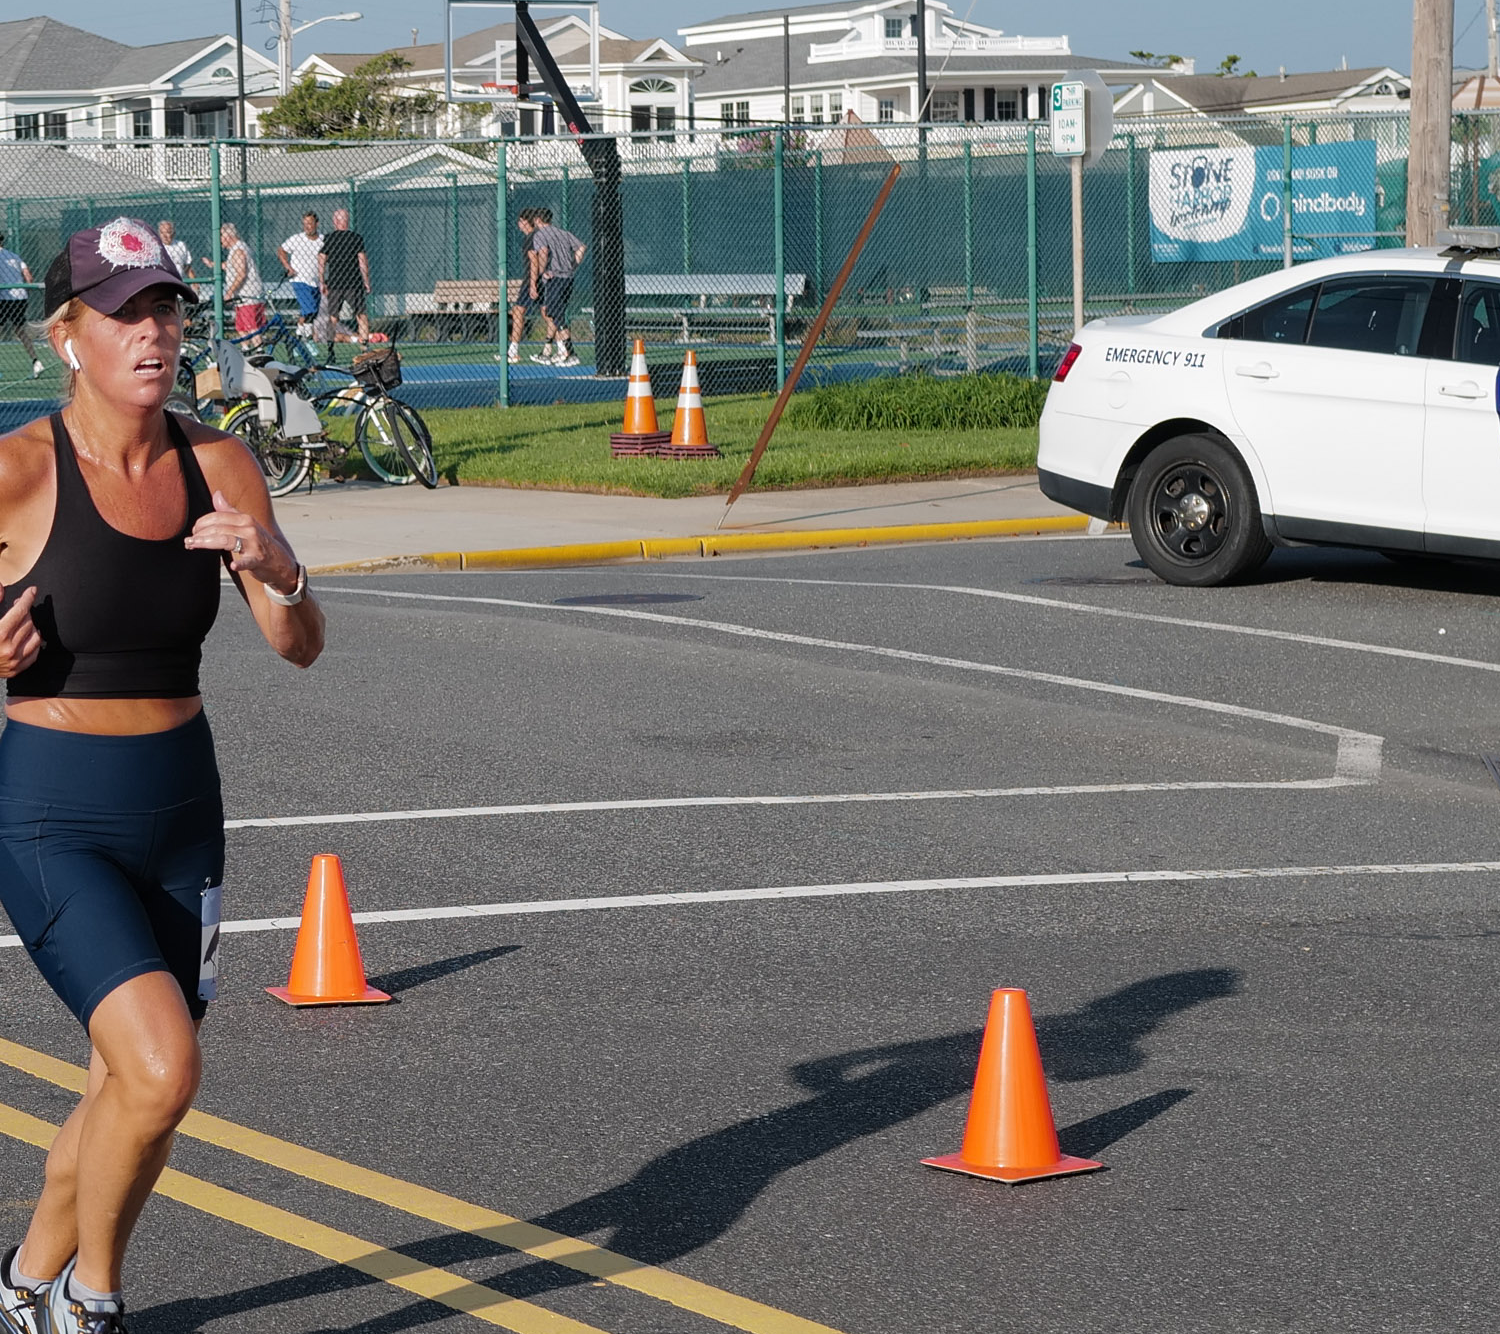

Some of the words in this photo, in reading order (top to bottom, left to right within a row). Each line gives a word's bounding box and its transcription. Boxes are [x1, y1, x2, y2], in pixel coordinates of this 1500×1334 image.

[1054, 88, 1062, 107] 3
[1062, 97, 1083, 107] PARKING
[1058, 118, 1078, 129] 10AM-
[1061, 134, 1076, 144] 9PM
[1169, 156, 1234, 190] STONE
[1105, 347, 1182, 366] EMERGENCY
[1183, 352, 1206, 368] 911
